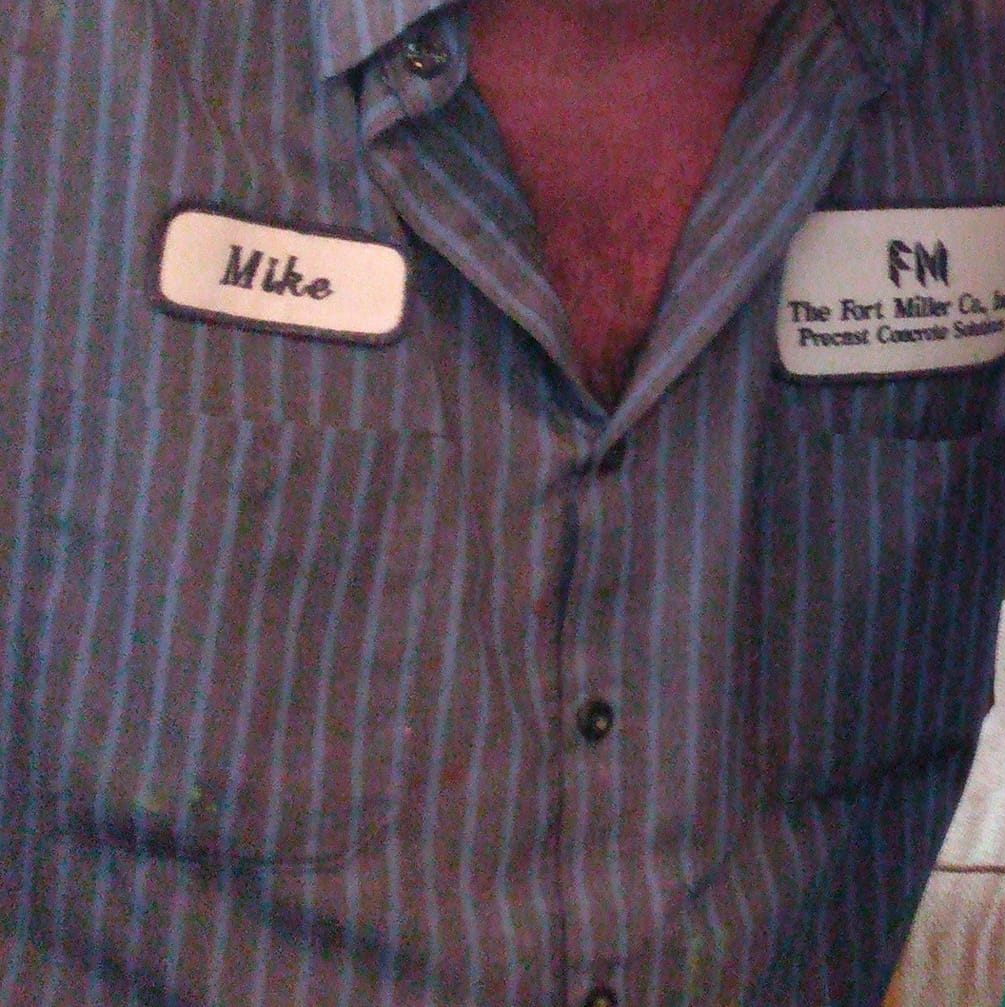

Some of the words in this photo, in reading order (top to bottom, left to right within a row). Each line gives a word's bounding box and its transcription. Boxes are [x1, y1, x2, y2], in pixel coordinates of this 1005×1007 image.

[220, 244, 334, 300] Mike
[788, 300, 831, 322] The
[839, 298, 885, 321] Fort
[894, 295, 951, 318] Miller
